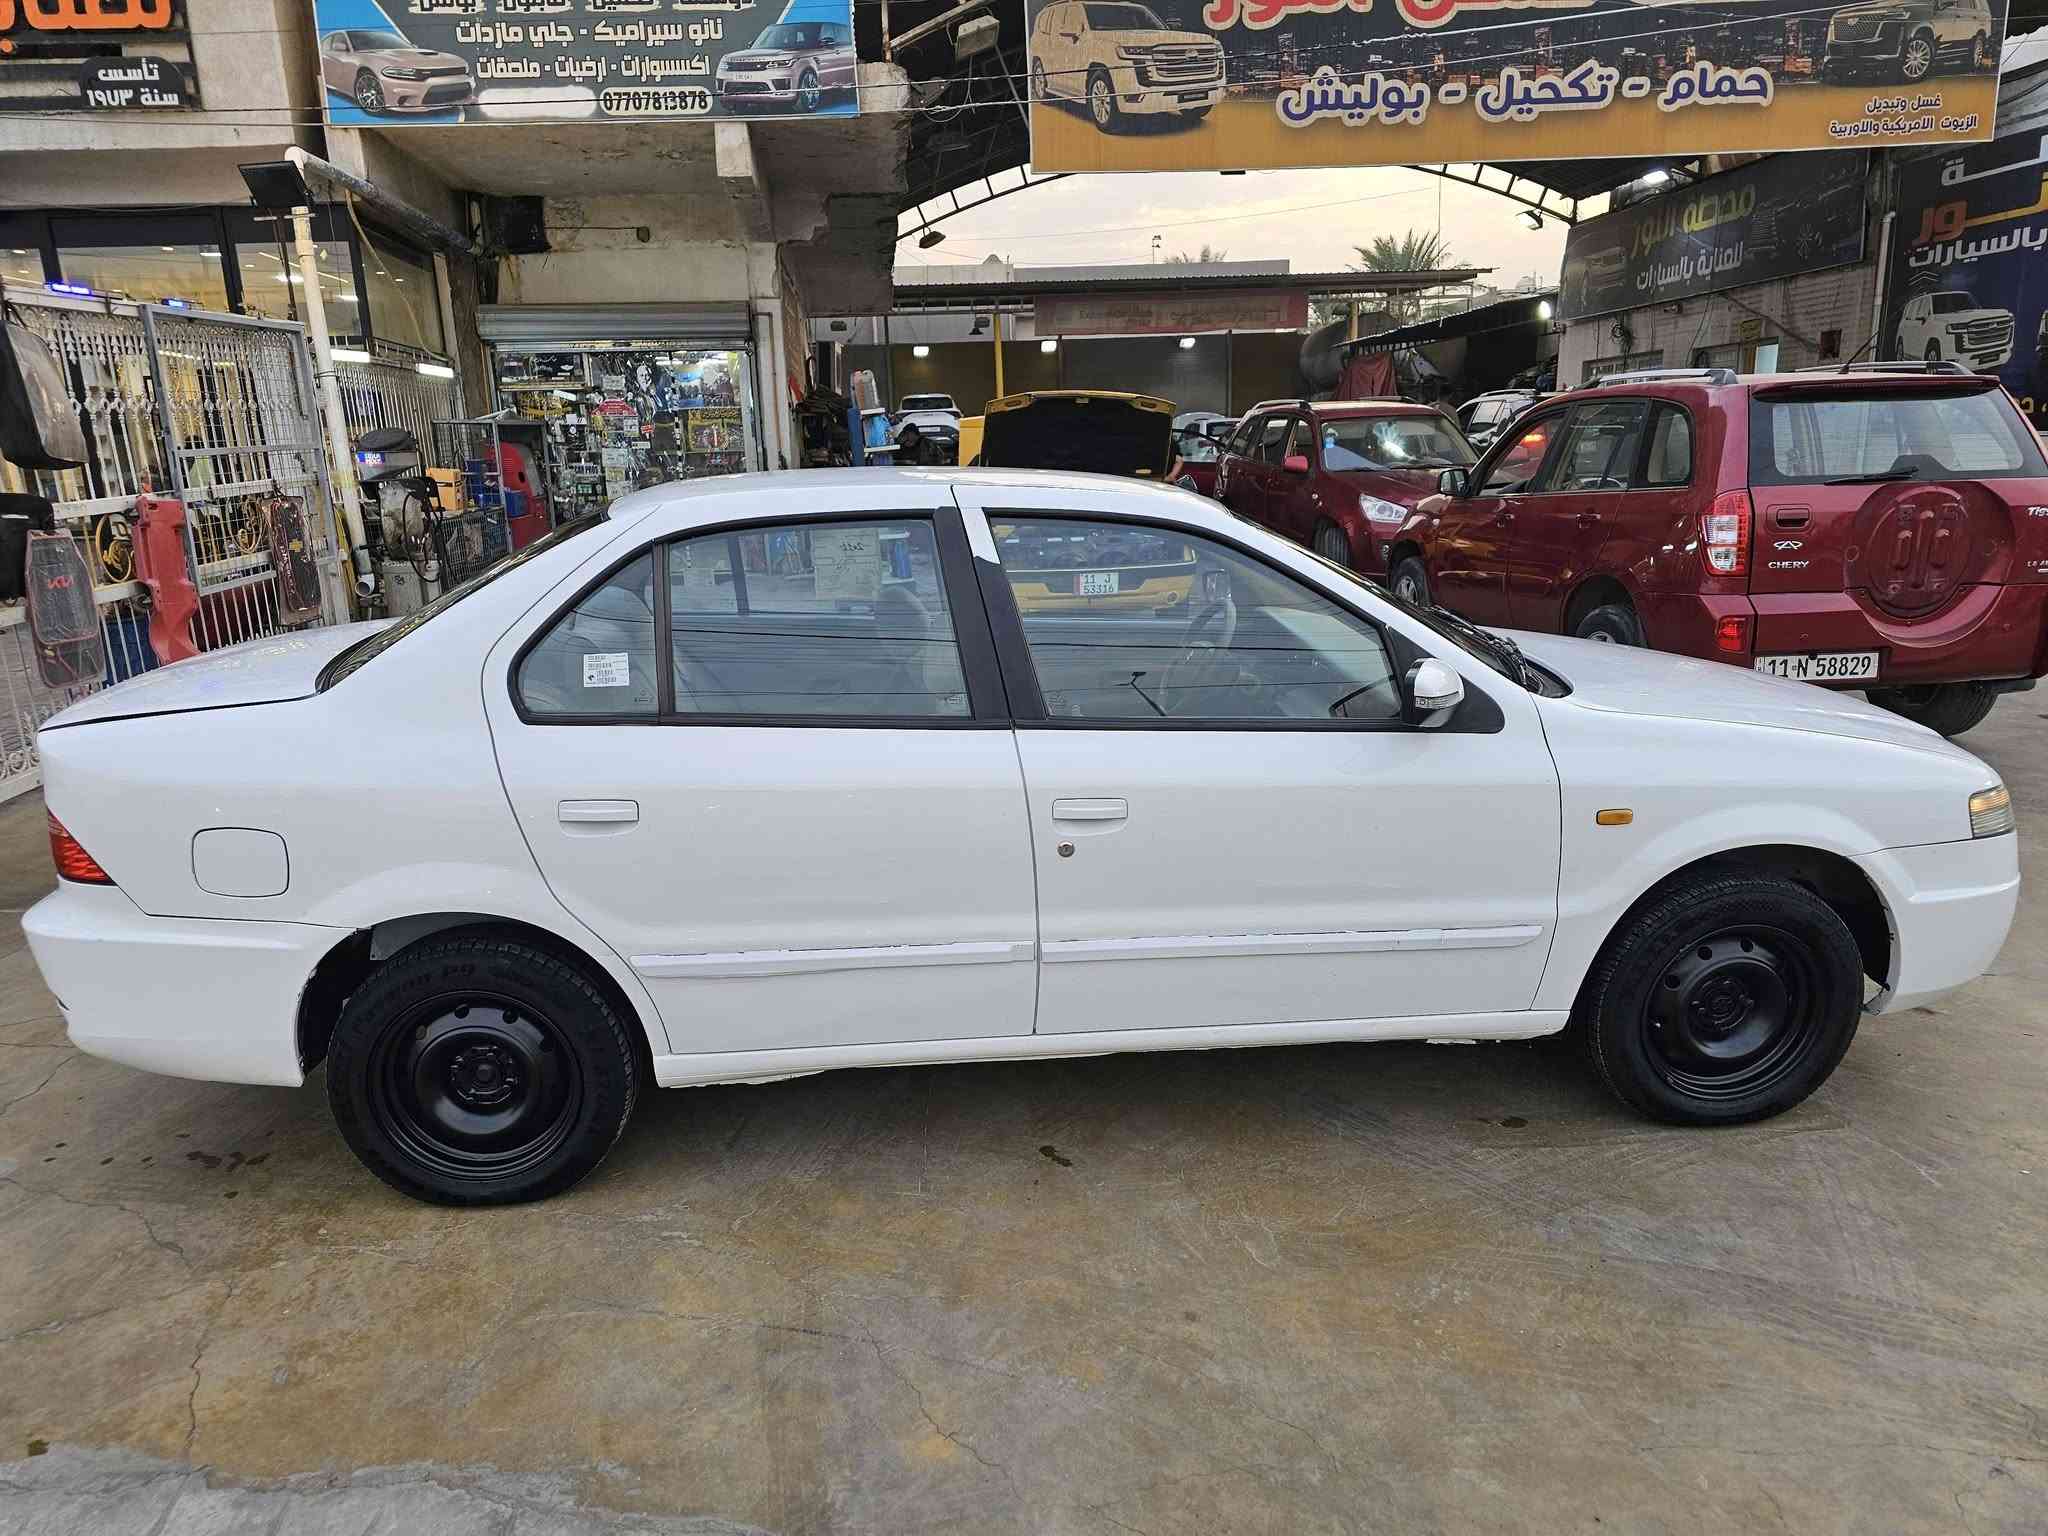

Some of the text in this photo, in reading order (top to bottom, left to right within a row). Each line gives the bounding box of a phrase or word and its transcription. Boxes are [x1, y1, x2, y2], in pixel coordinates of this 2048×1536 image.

[455, 21, 524, 49] مازدات
[528, 20, 576, 47] جلي
[594, 19, 684, 46] سيراميك
[688, 17, 724, 46] نانو
[476, 53, 711, 83] اكسسوارات ارضيات ملصقات
[86, 87, 179, 106] سنة ١٩٧٣
[1279, 69, 1428, 124] بوليش
[1479, 62, 1617, 119] تكحيل
[1659, 64, 1771, 108] حمام
[1911, 93, 1942, 111] غسل
[1768, 560, 1809, 569] CHERY
[1768, 656, 1872, 678] 11 N 58829
